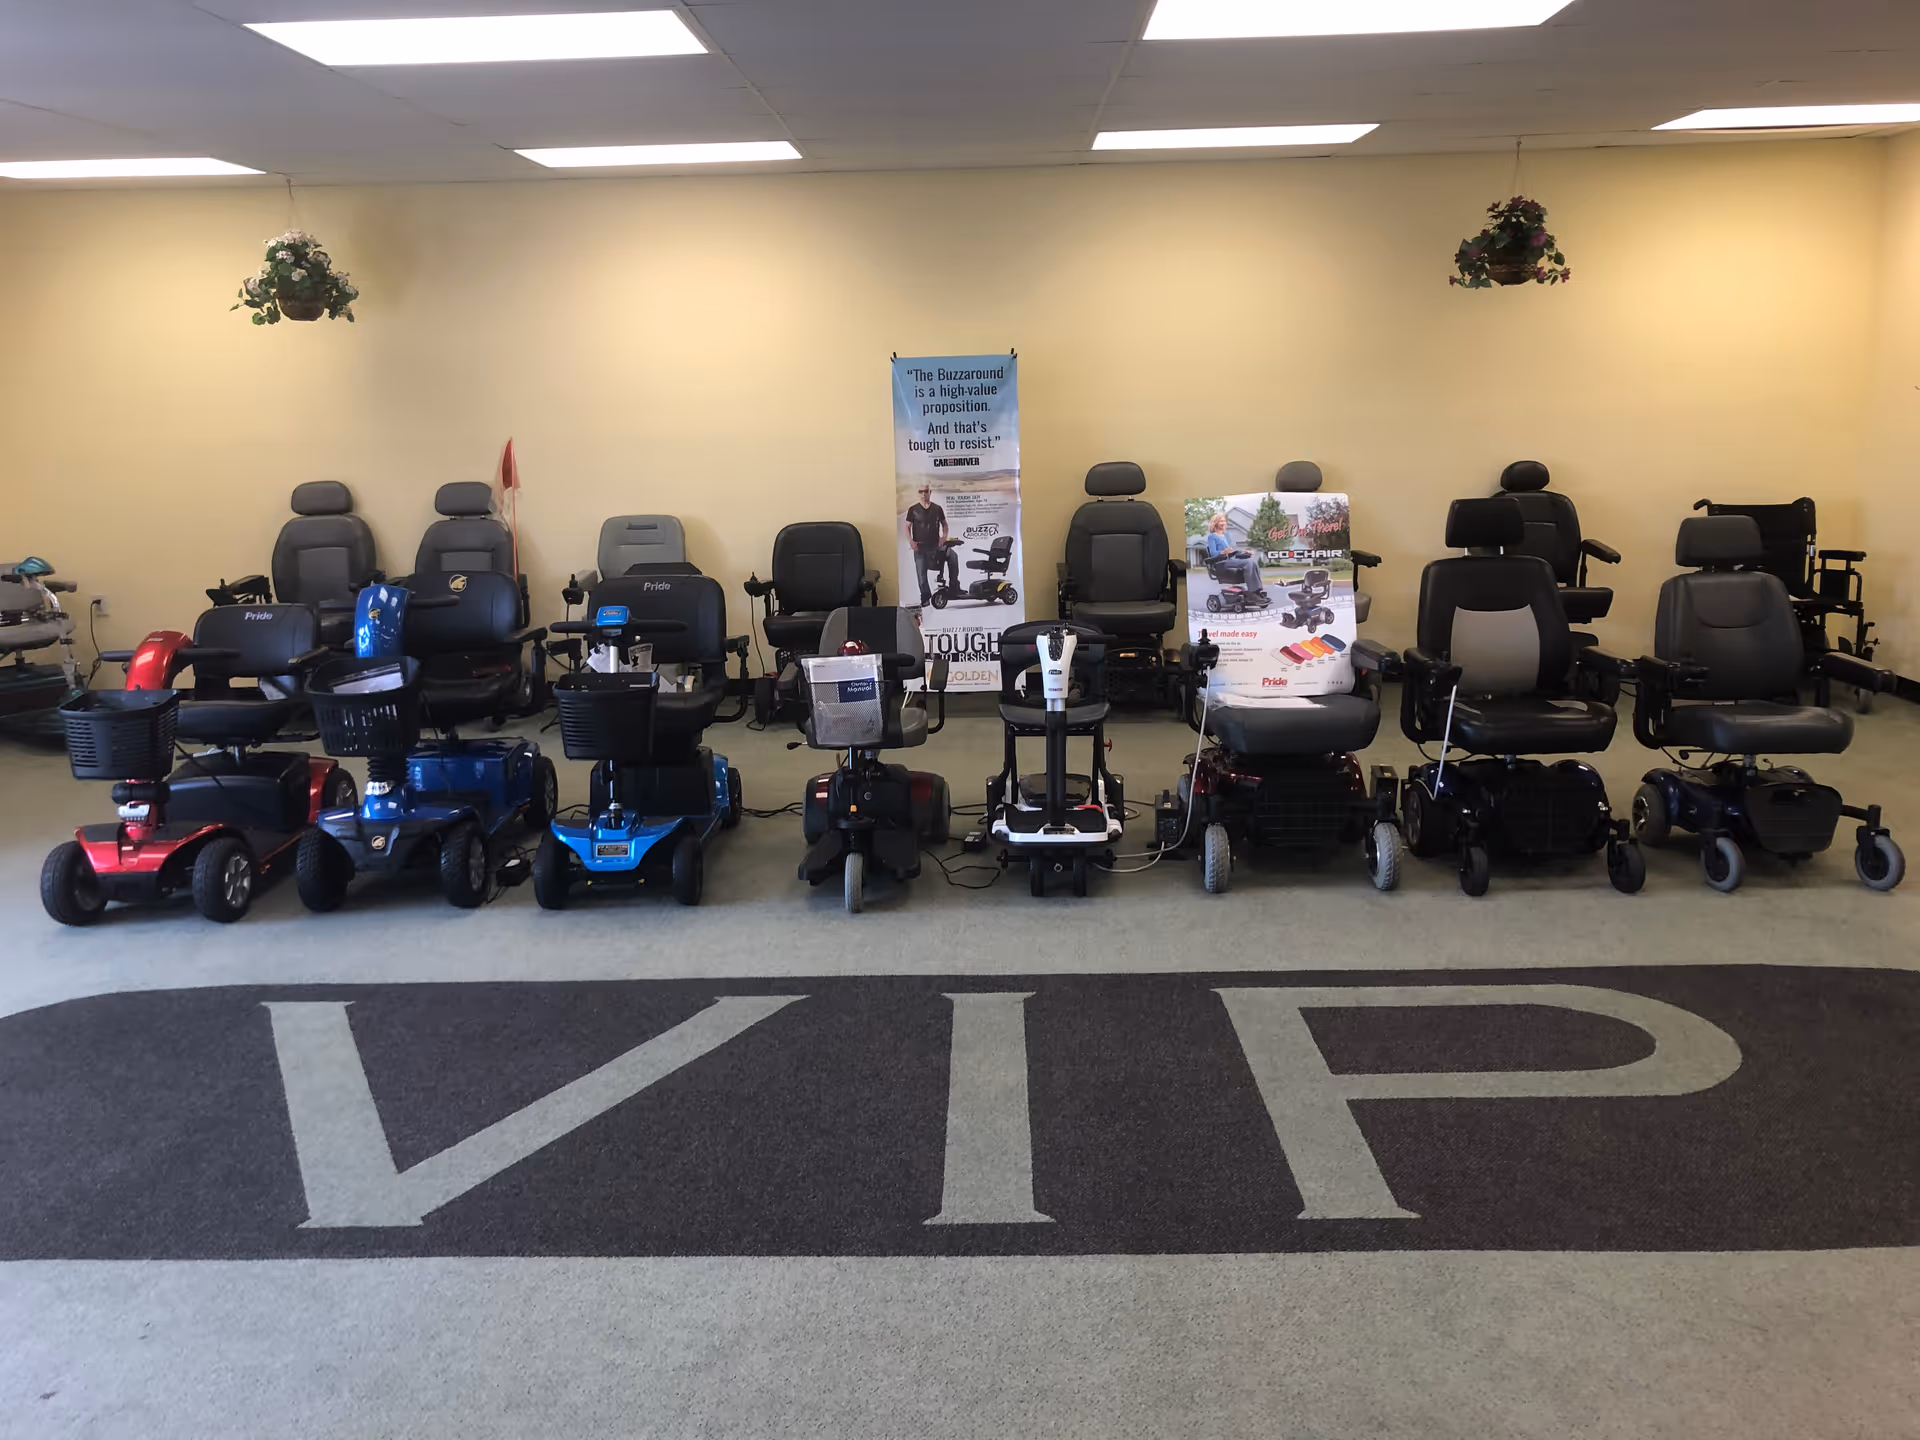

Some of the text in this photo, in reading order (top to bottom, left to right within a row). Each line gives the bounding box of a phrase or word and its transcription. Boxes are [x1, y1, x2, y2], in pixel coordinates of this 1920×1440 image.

[938, 366, 1004, 381] Buzzaround
[915, 383, 997, 399] is a high-value
[922, 400, 991, 416] proposition.
[928, 421, 987, 435] And that’s
[908, 438, 939, 453] tough
[945, 438, 955, 450] to
[933, 458, 948, 467] CAR
[953, 457, 980, 466] DRIVER
[1268, 524, 1287, 541] Get
[1310, 517, 1343, 534] There!
[643, 582, 671, 591] Pride
[244, 612, 273, 620] Pride
[1220, 630, 1239, 638] made
[1241, 631, 1257, 639] easy
[925, 632, 1001, 653] TOUGH
[960, 652, 992, 662] RESIST
[1261, 677, 1288, 686] Pride
[258, 984, 1743, 1230] VIP
